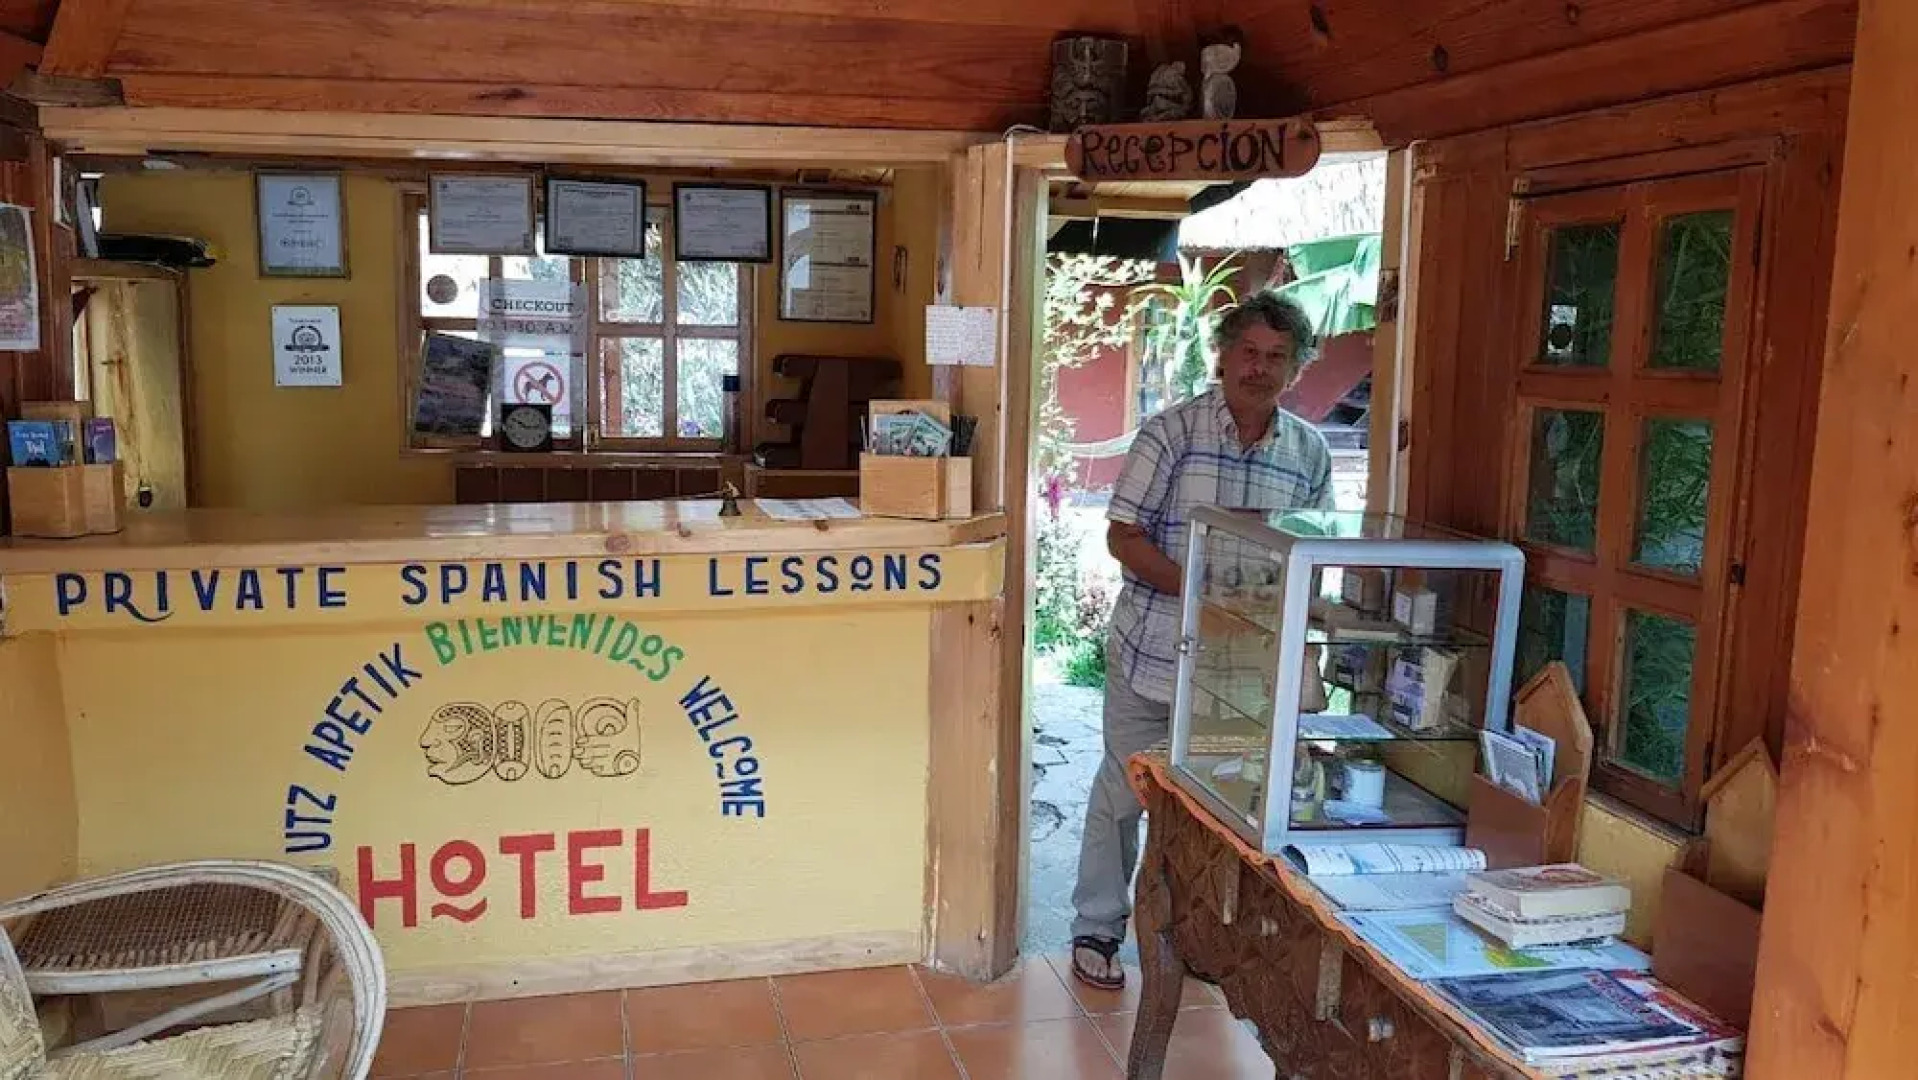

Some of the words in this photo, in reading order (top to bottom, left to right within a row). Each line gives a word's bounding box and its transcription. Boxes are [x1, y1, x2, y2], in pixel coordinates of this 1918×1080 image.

[492, 298, 574, 311] CHECKOUT
[294, 354, 323, 365] 2013
[57, 567, 347, 621] PRIVATE
[403, 560, 662, 606] SPANISH
[709, 554, 943, 596] LESSONS
[425, 613, 685, 682] BIENVENIDOS
[304, 643, 422, 772] APETIK
[679, 674, 765, 819] WELCOME
[285, 784, 338, 854] UTZ
[357, 828, 689, 929] HOTEL
